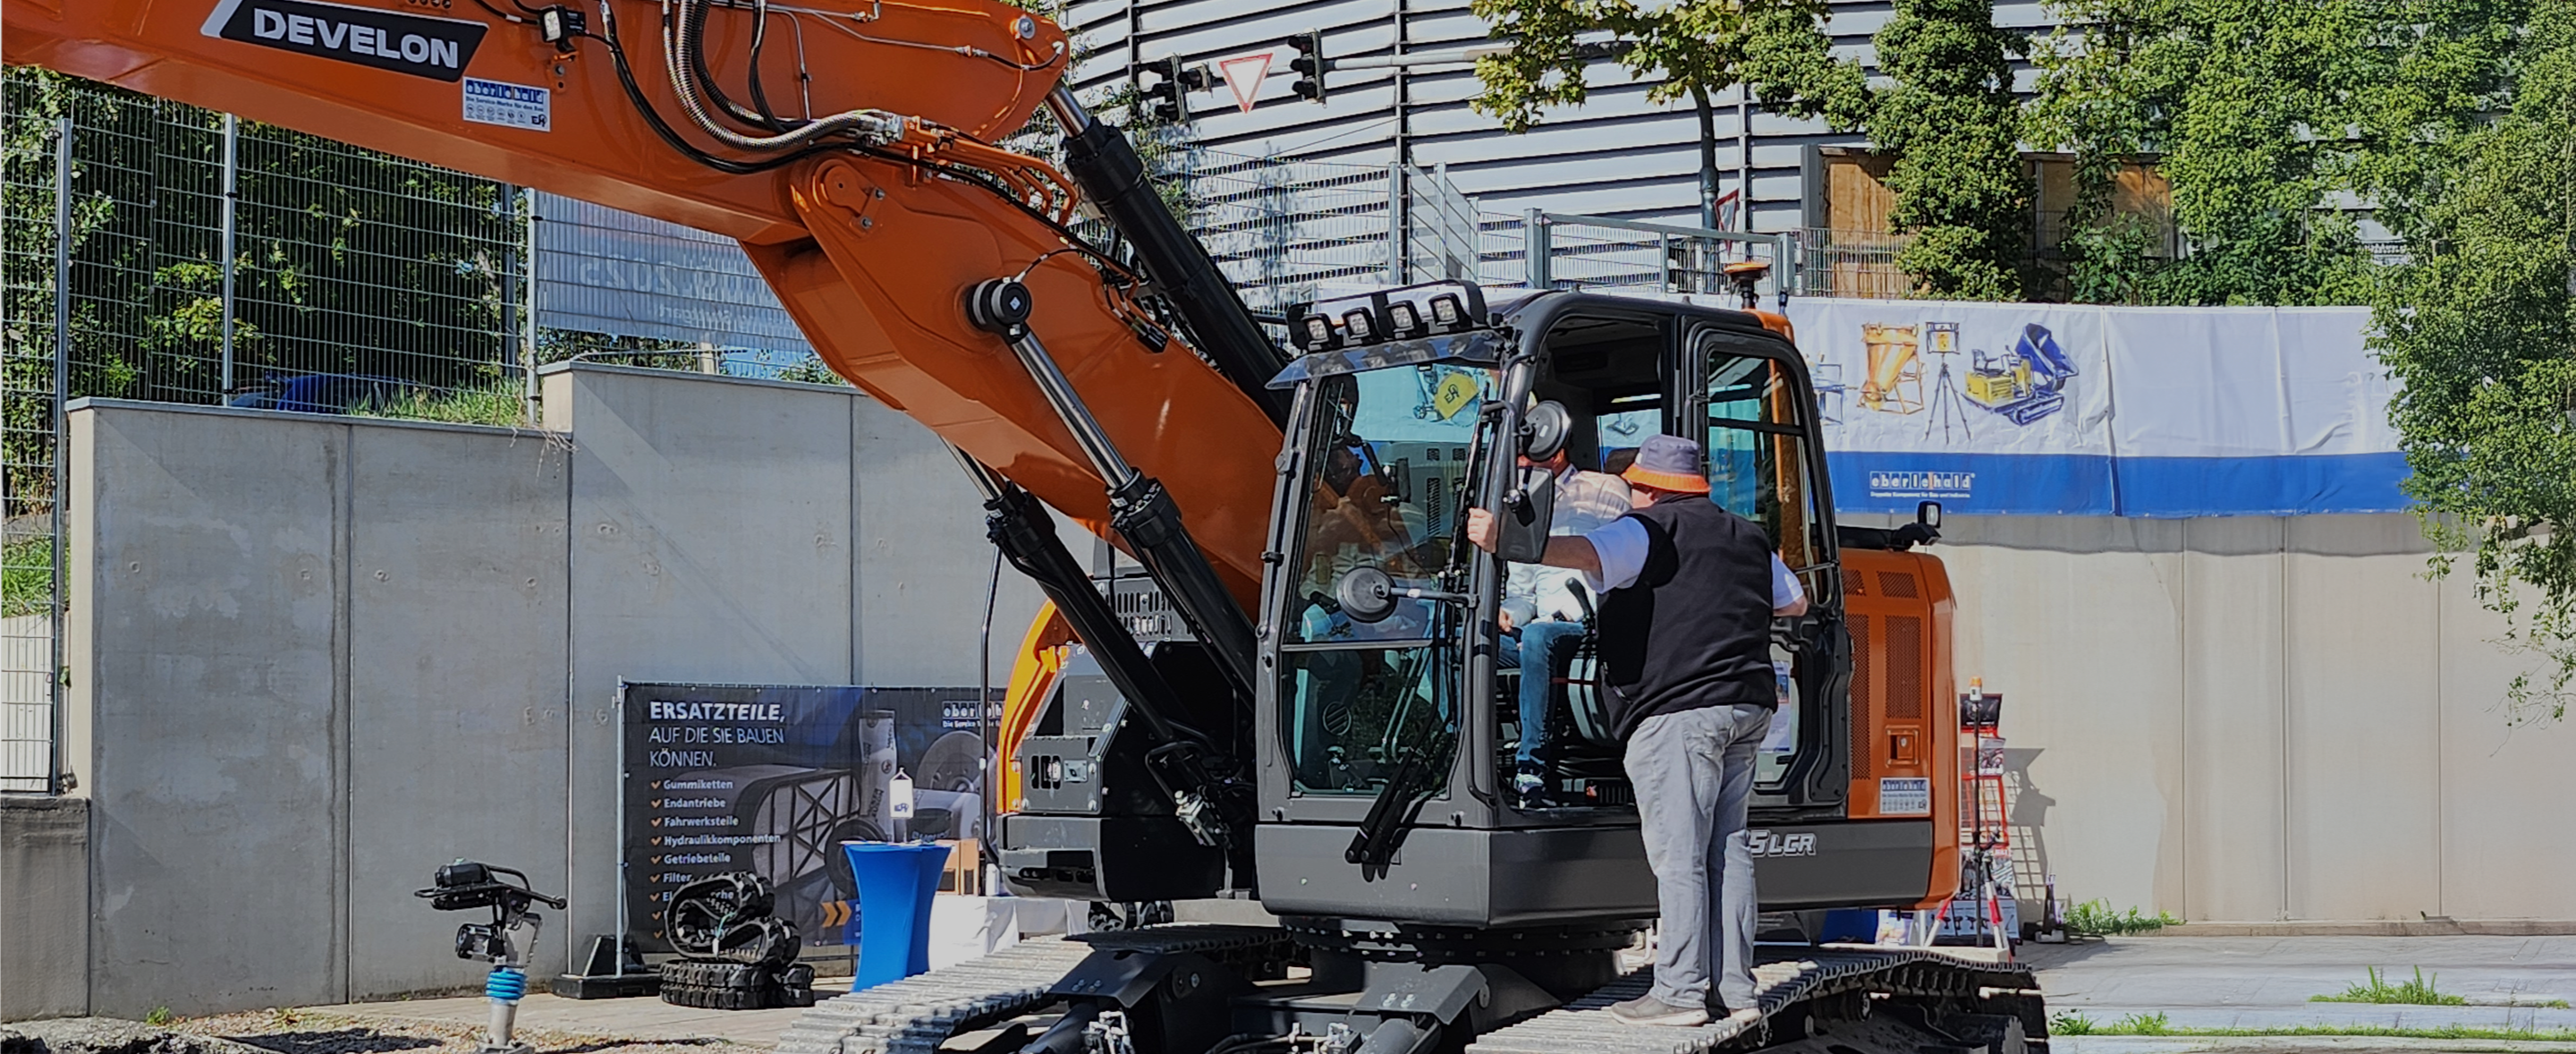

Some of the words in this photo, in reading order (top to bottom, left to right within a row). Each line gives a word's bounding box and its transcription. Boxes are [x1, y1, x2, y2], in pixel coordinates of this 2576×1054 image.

[254, 8, 458, 69] DEVELON
[649, 701, 785, 722] ERSATZTEILE,
[648, 727, 681, 743] AUF
[684, 727, 708, 744] DIE
[713, 727, 733, 744] SIE
[737, 727, 784, 744] BAUEN
[649, 747, 716, 767] KÖNNEN.
[664, 779, 733, 790] Gummiketten
[664, 797, 726, 808] Endantriebe
[665, 815, 739, 827] Fahrwerksteile
[664, 834, 781, 847] Hydraulikkomponenten
[1750, 829, 1817, 857] 5LCR
[664, 853, 731, 864] Getriebeteile
[663, 872, 691, 883] Filter
